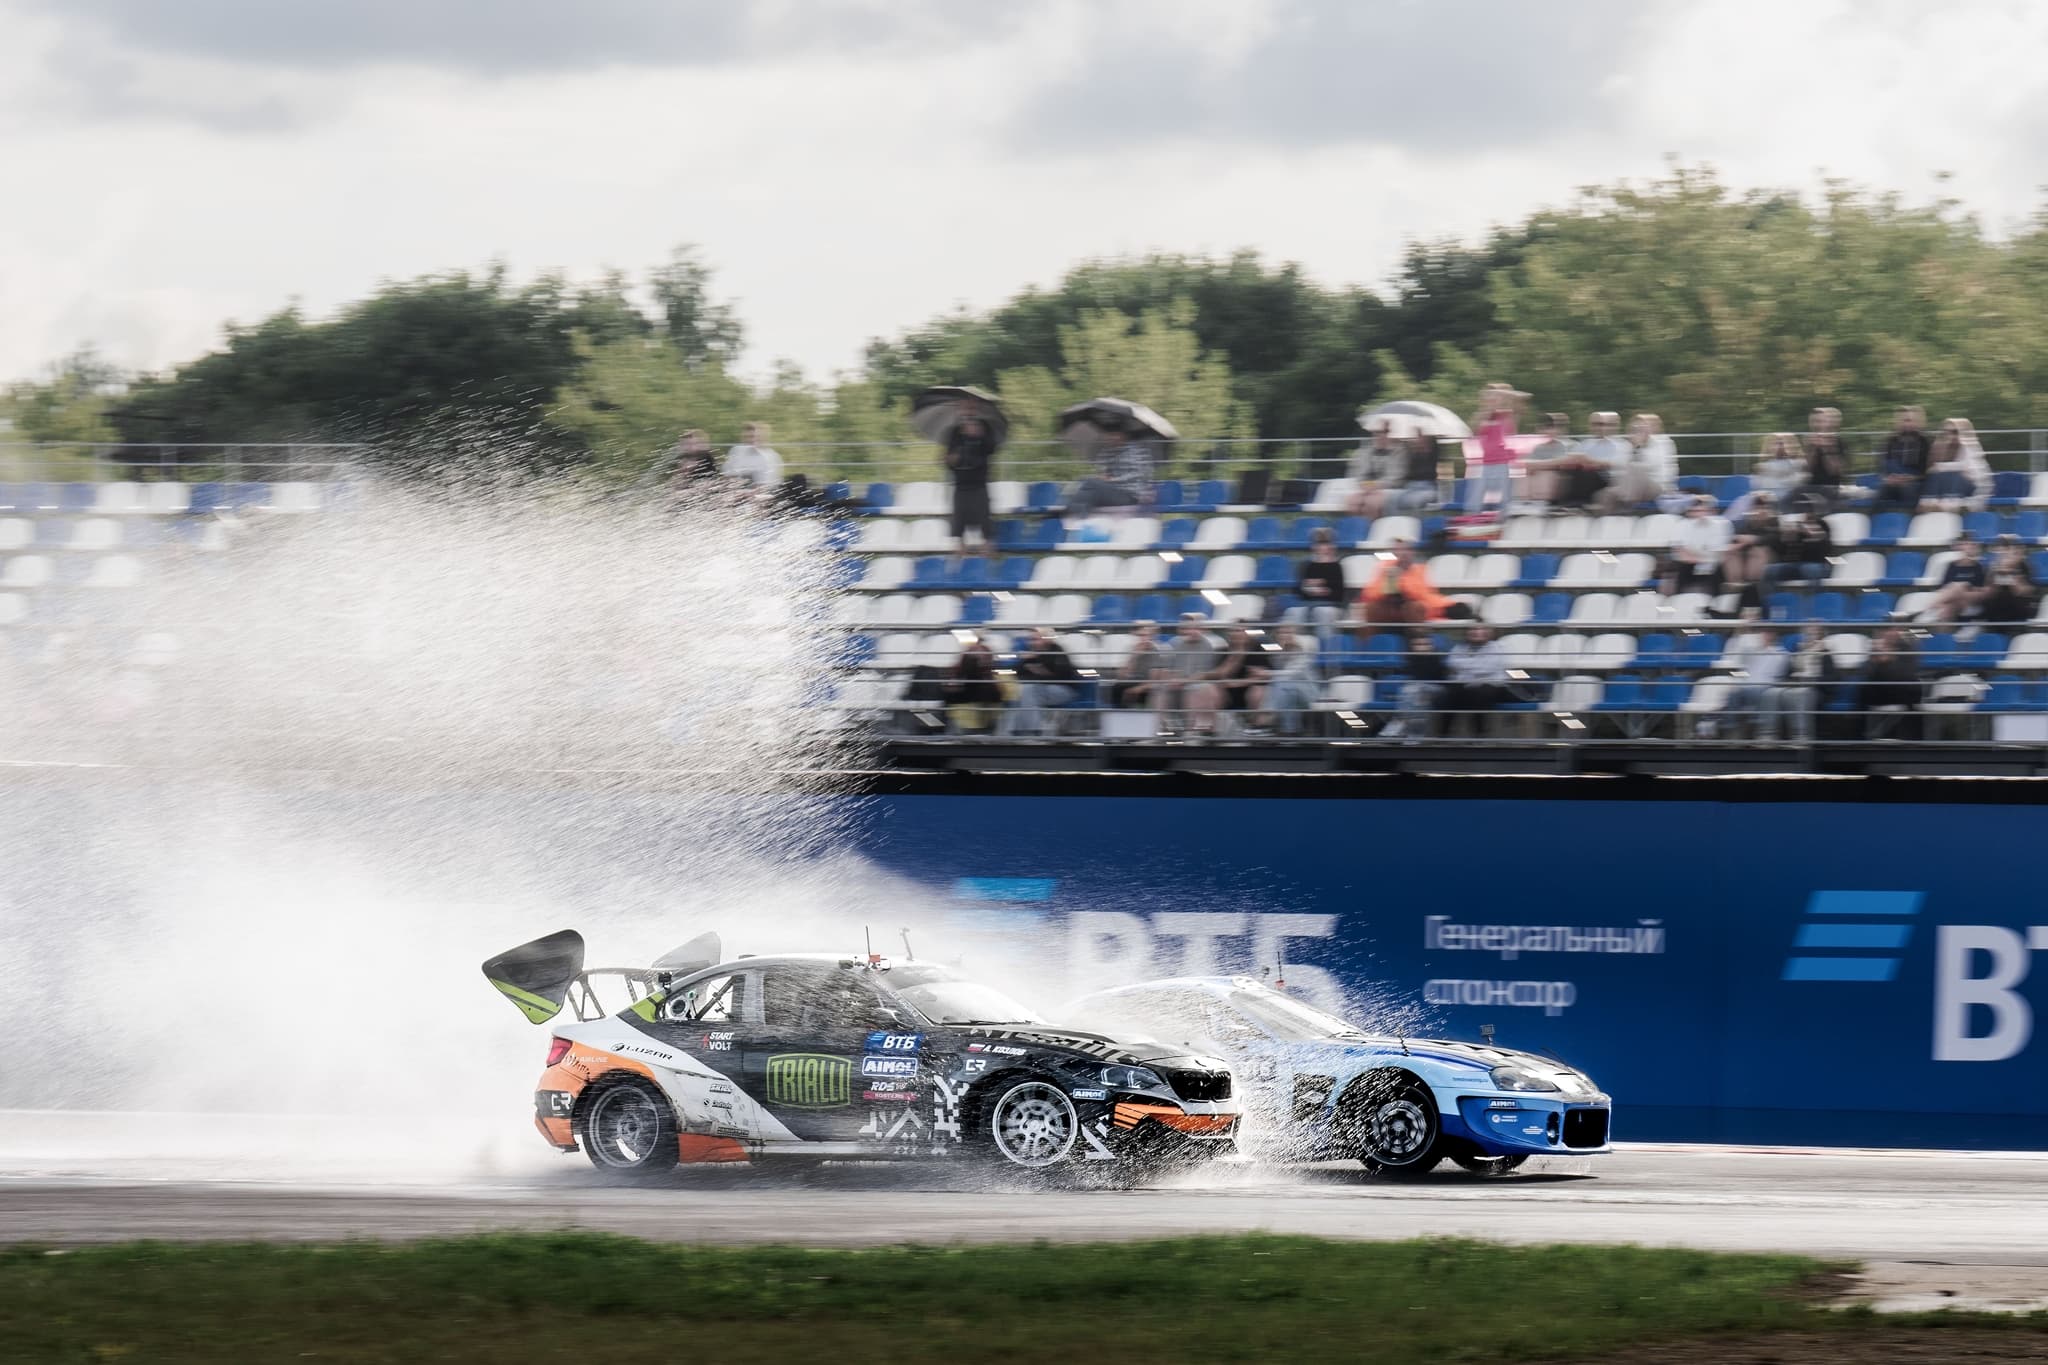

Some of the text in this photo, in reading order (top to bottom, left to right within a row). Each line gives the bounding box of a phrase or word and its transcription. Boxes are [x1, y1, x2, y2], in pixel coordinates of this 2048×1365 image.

[1424, 915, 1666, 960] Генеральный
[1423, 979, 1577, 1016] спонсор
[1931, 925, 2048, 1061] В
[709, 1031, 734, 1040] START
[882, 1035, 917, 1049] ВТБ
[626, 1045, 673, 1061] LUZAR
[709, 1041, 732, 1051] VOLT
[864, 1059, 916, 1074] AIMOL
[771, 1058, 845, 1104] TRIALLI
[870, 1081, 896, 1091] RDS
